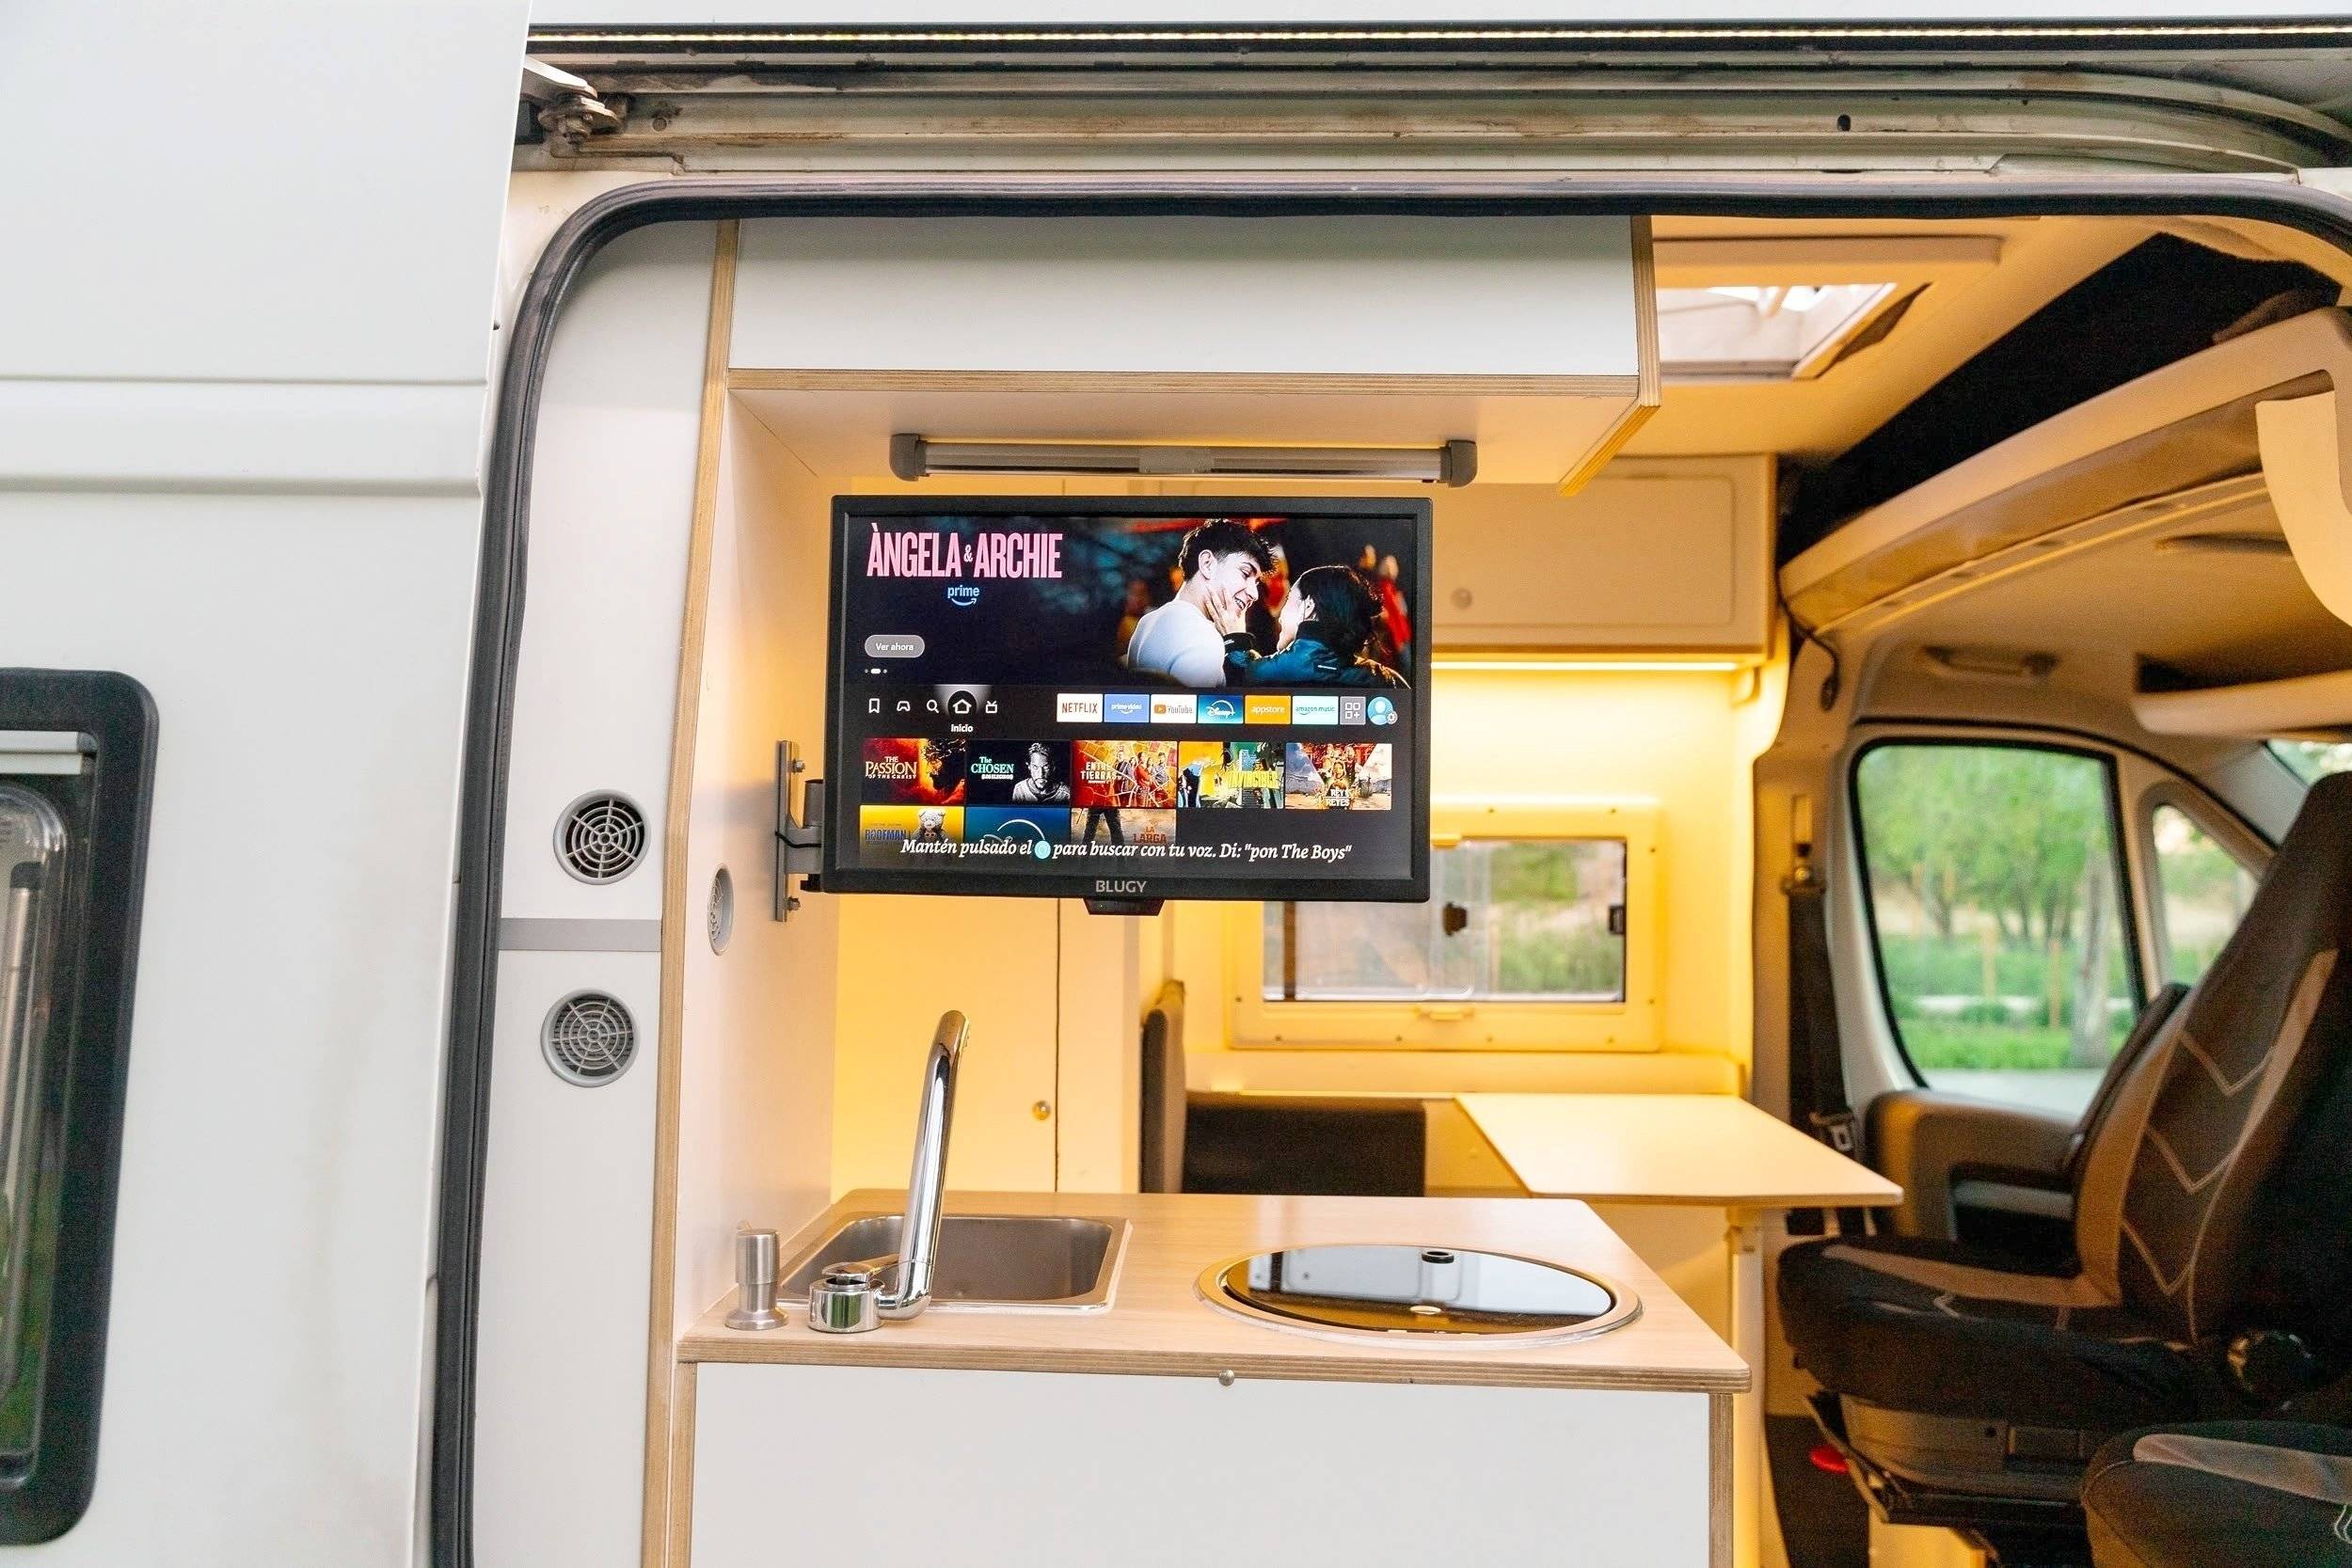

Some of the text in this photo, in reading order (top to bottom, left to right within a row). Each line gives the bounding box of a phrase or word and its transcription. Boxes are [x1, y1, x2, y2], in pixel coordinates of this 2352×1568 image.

[866, 522, 1063, 578] ÀNGELA & ARCHIE
[947, 584, 979, 597] prime
[875, 642, 914, 651] Ver ahora
[1061, 703, 1098, 714] NETFLIX
[1168, 705, 1193, 714] YouTube
[1250, 705, 1285, 716] appstore
[1295, 705, 1317, 714] amazon
[950, 722, 974, 733] Inicio
[865, 761, 917, 776] PASSION
[970, 763, 1014, 774] CHOSEN
[1080, 770, 1117, 780] TIERRAS
[1134, 833, 1167, 844] LARGA
[900, 838, 957, 854] Mantén
[960, 839, 1017, 858] pulsado
[1019, 840, 1032, 855] el
[1052, 843, 1087, 859] para
[1089, 841, 1138, 857] buscar
[1140, 845, 1166, 857] con
[1168, 844, 1185, 857] tu
[1187, 846, 1216, 858] voz.
[1219, 843, 1241, 859] Di:
[1245, 844, 1279, 862] "pon
[1280, 844, 1309, 860] The
[1311, 845, 1352, 863] Boys"
[1095, 879, 1147, 893] BLUGY
